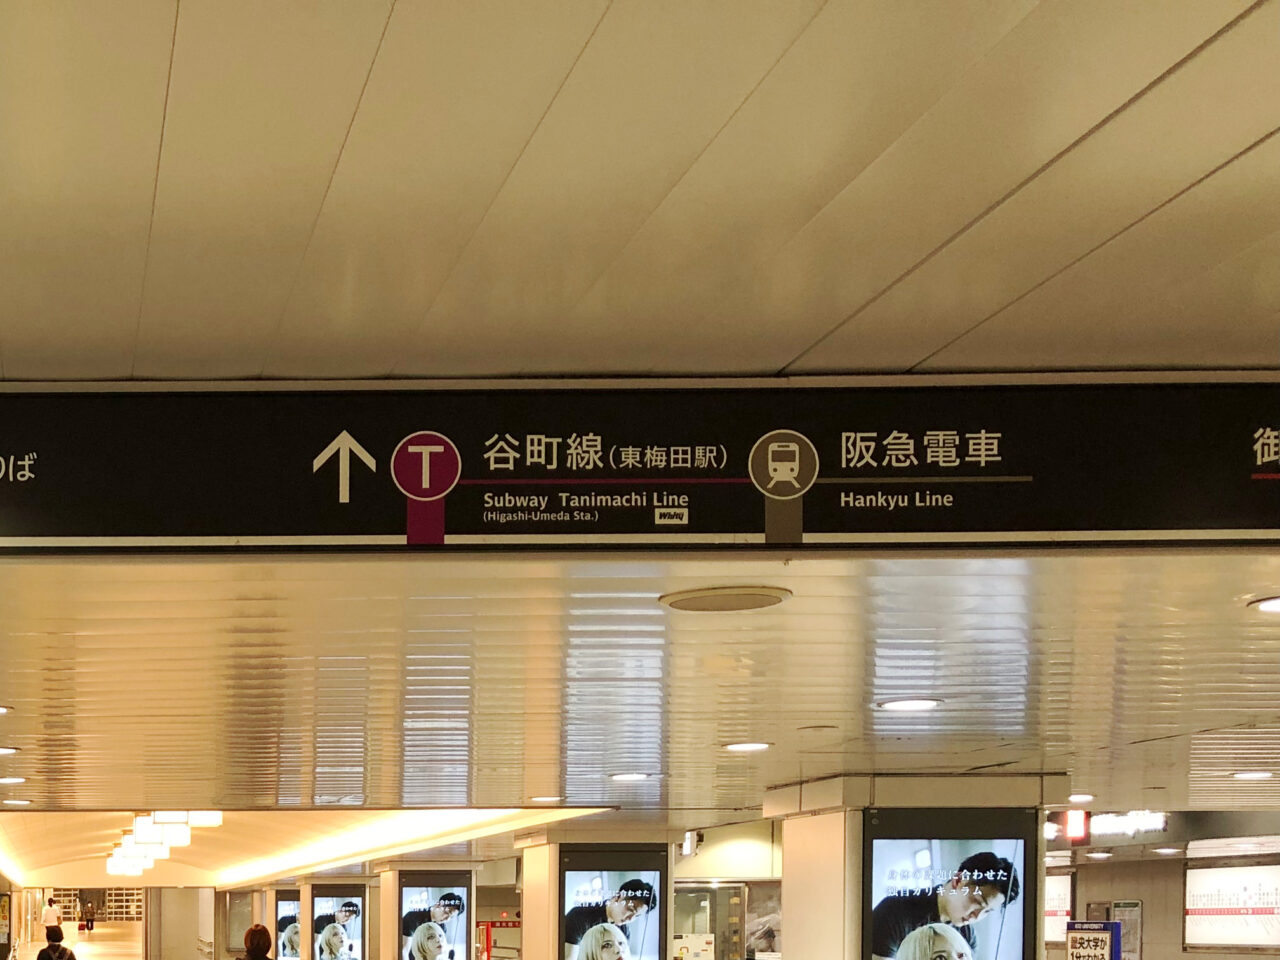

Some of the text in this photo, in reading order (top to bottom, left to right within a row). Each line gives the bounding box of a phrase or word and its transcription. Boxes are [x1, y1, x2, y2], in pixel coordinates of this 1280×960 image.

[841, 430, 1002, 468] 阪急電車
[407, 445, 445, 489] T
[484, 492, 689, 509] Subway Tanimachi Line
[840, 491, 954, 511] Hankyu Line
[483, 511, 599, 523] (Higashi-Umeda Sta.)
